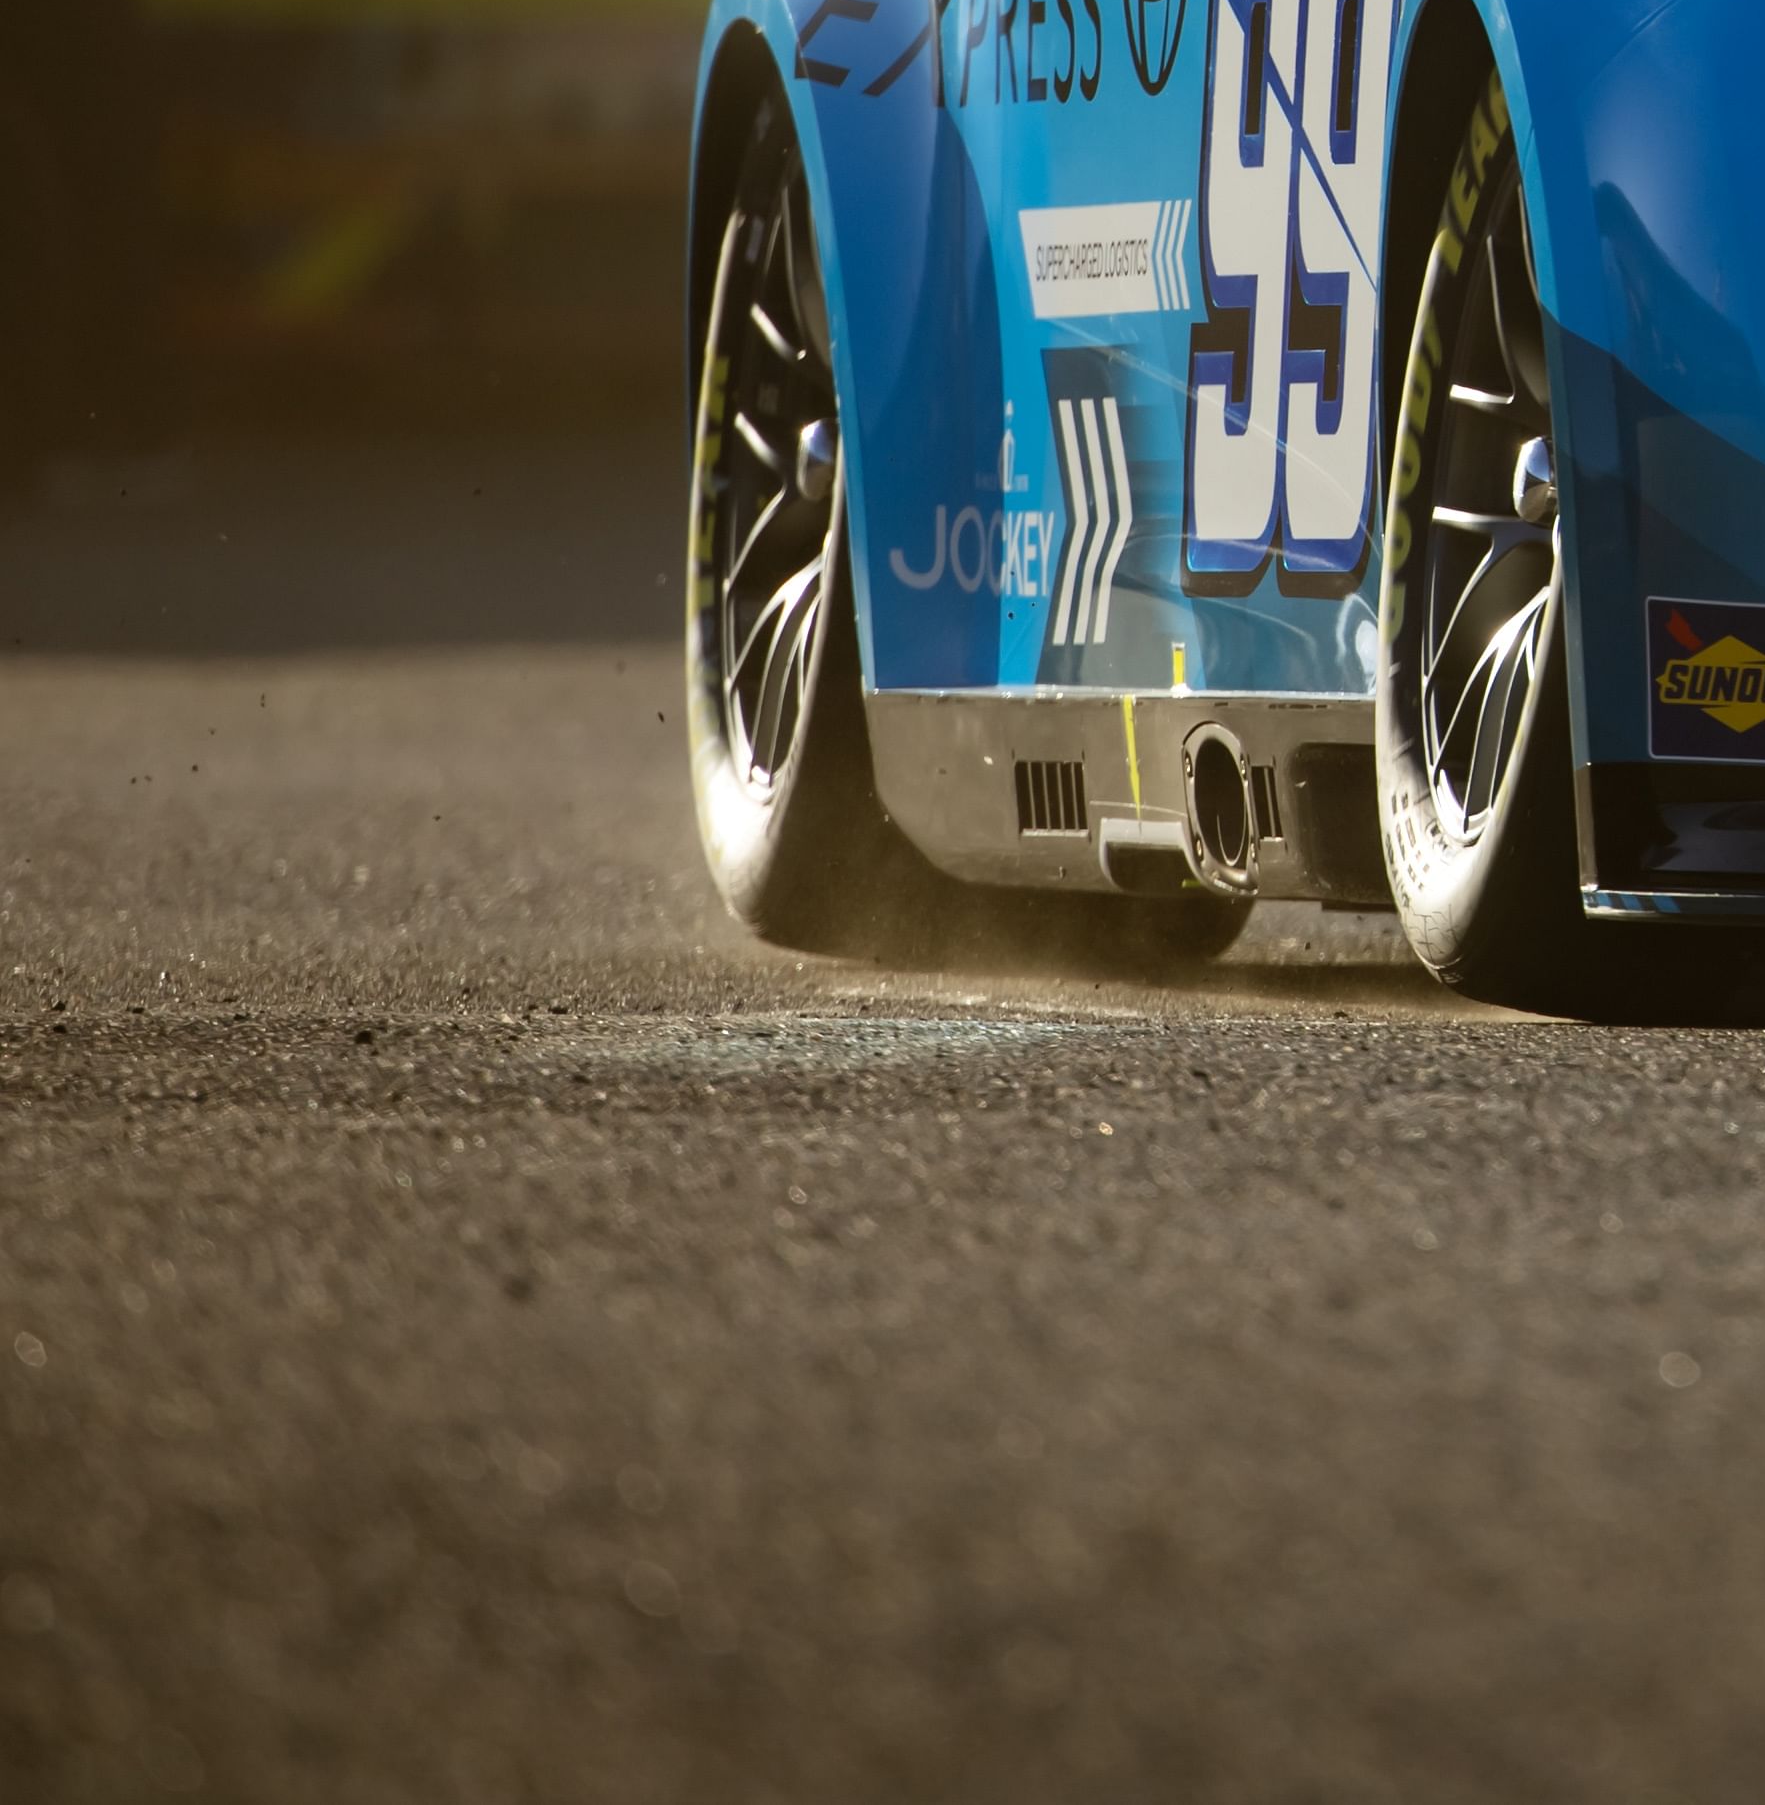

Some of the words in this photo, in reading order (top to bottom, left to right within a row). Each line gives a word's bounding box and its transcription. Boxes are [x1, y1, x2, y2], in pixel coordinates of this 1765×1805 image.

[1036, 241, 1103, 281] SUPERCHARGED
[1105, 238, 1149, 278] LOGISTICS
[889, 503, 1055, 597] JOCKEY
